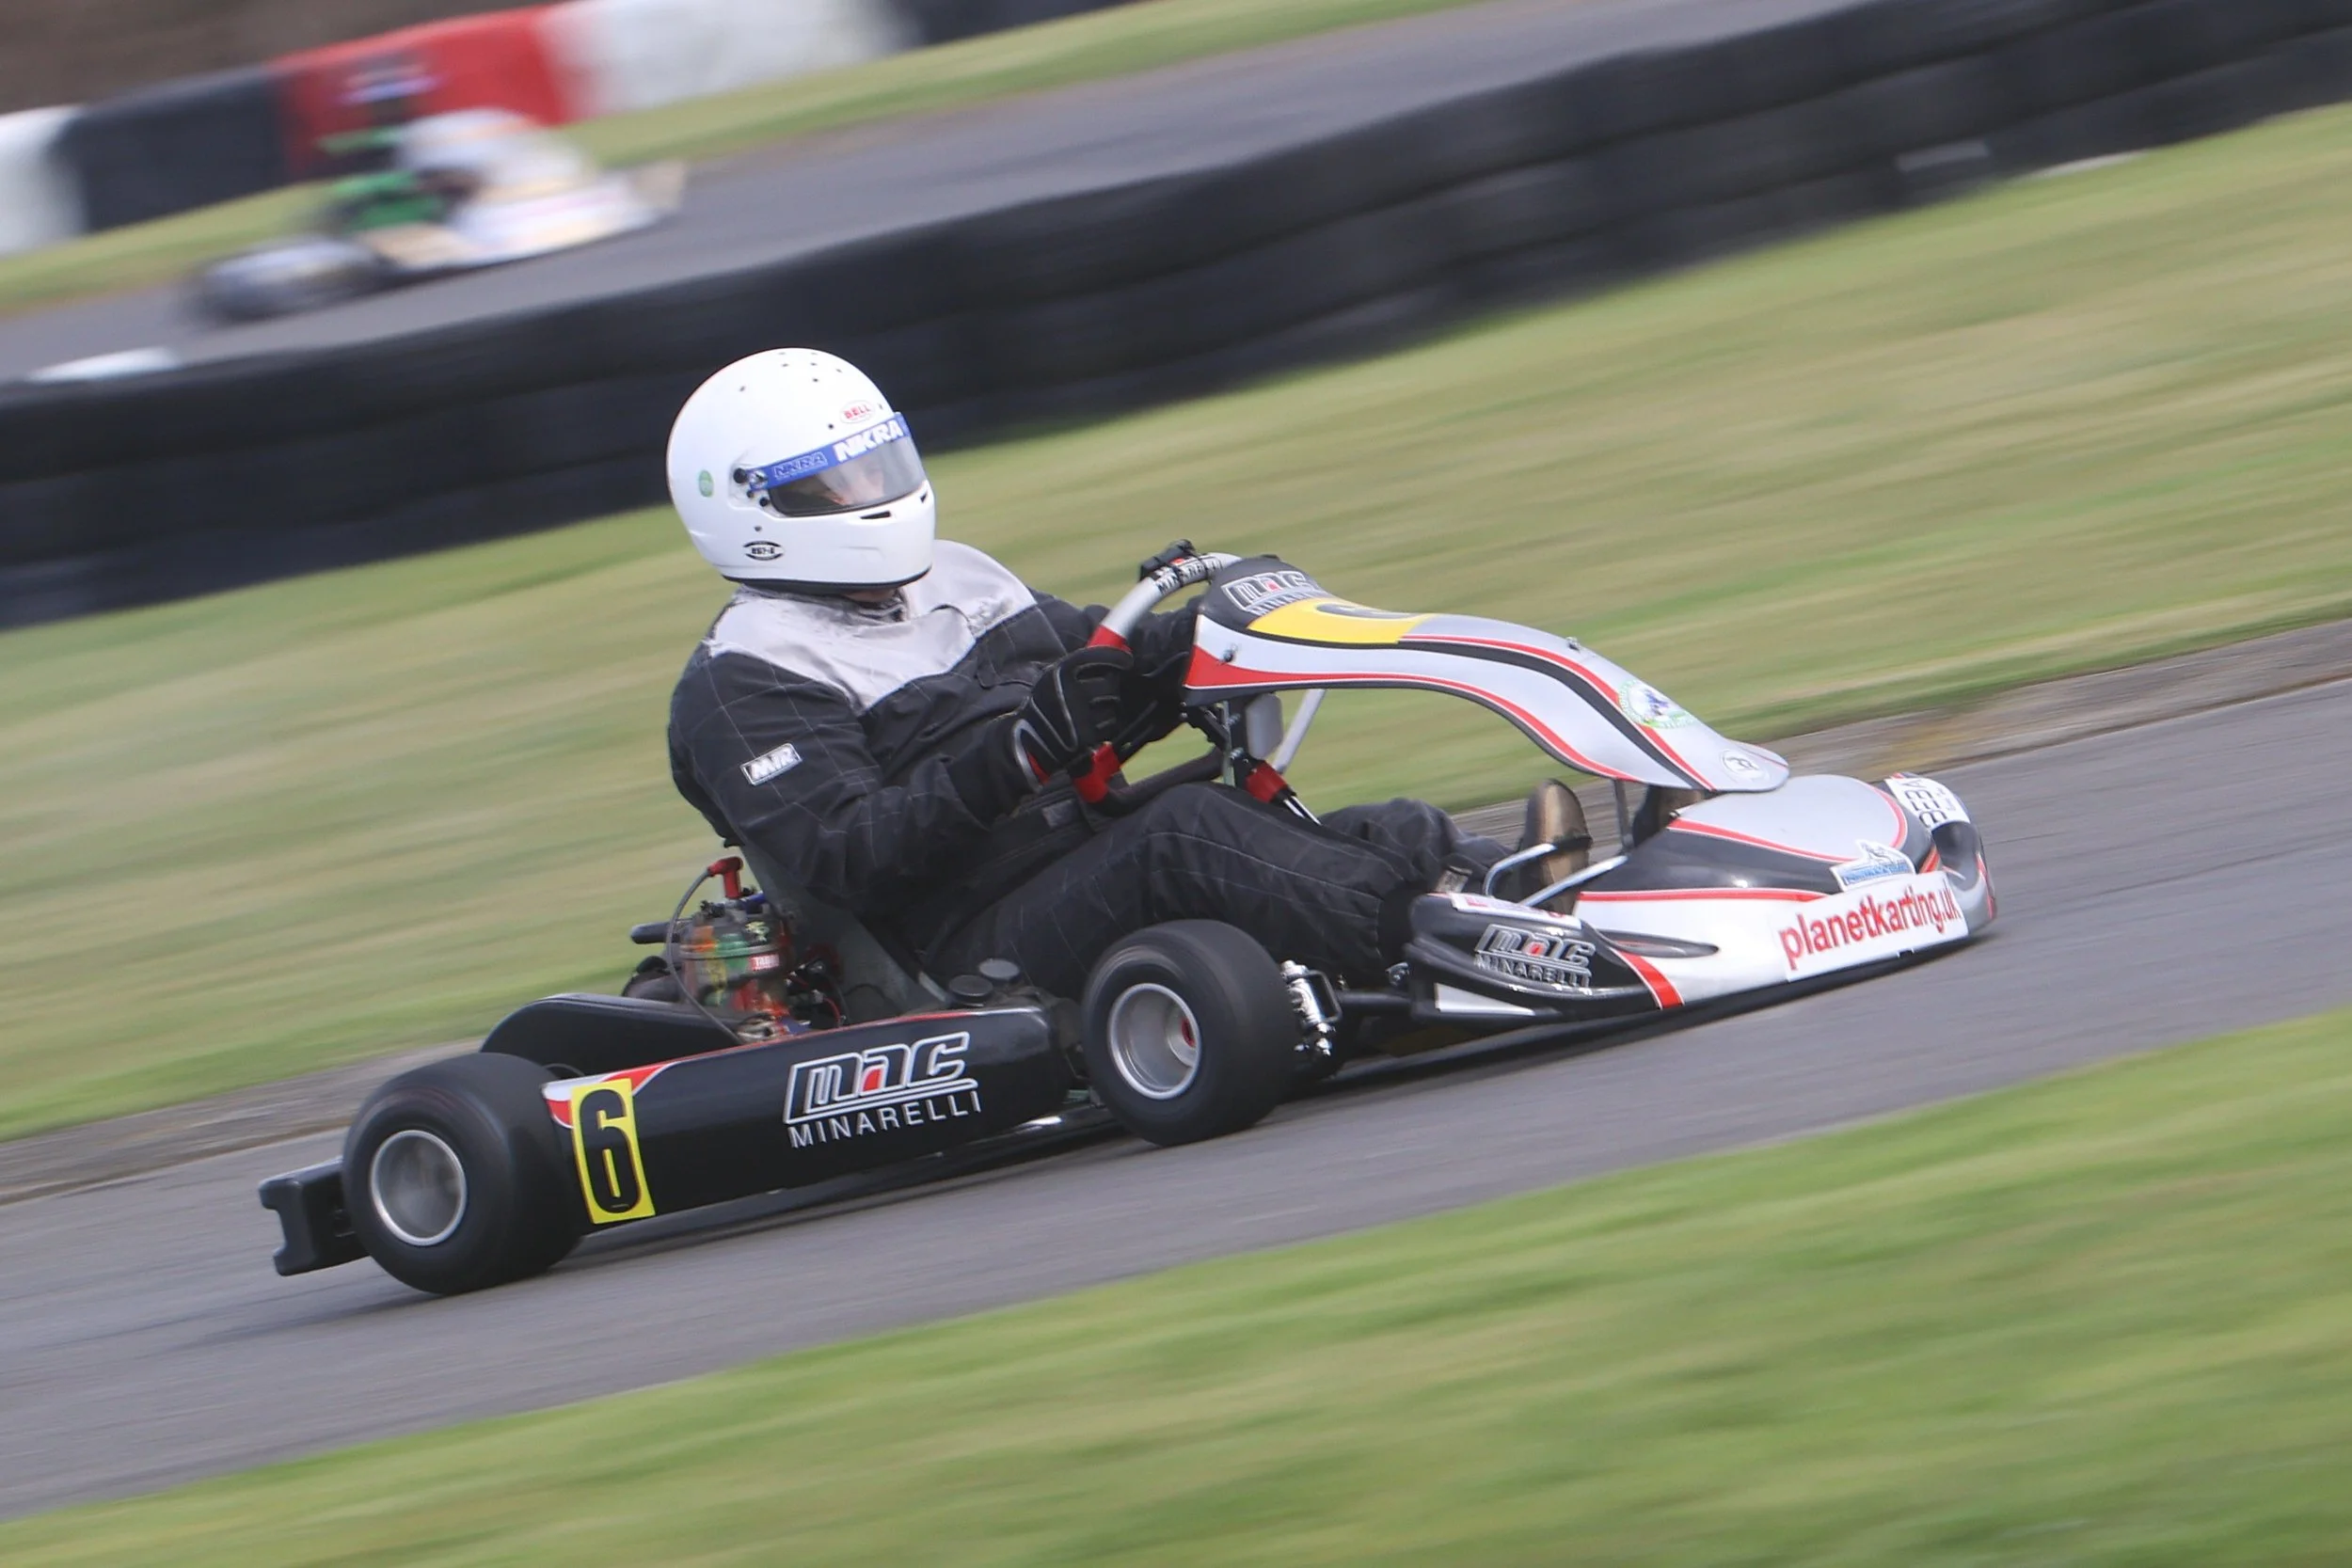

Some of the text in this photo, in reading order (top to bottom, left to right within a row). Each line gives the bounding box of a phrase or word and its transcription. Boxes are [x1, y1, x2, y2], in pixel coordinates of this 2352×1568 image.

[843, 404, 871, 420] BELL
[834, 420, 903, 463] NKRA
[1778, 879, 1963, 972] planetkarting.uk
[1473, 953, 1593, 989] MINARELLI
[787, 1090, 982, 1148] MINARELLI
[579, 1087, 642, 1214] 6
